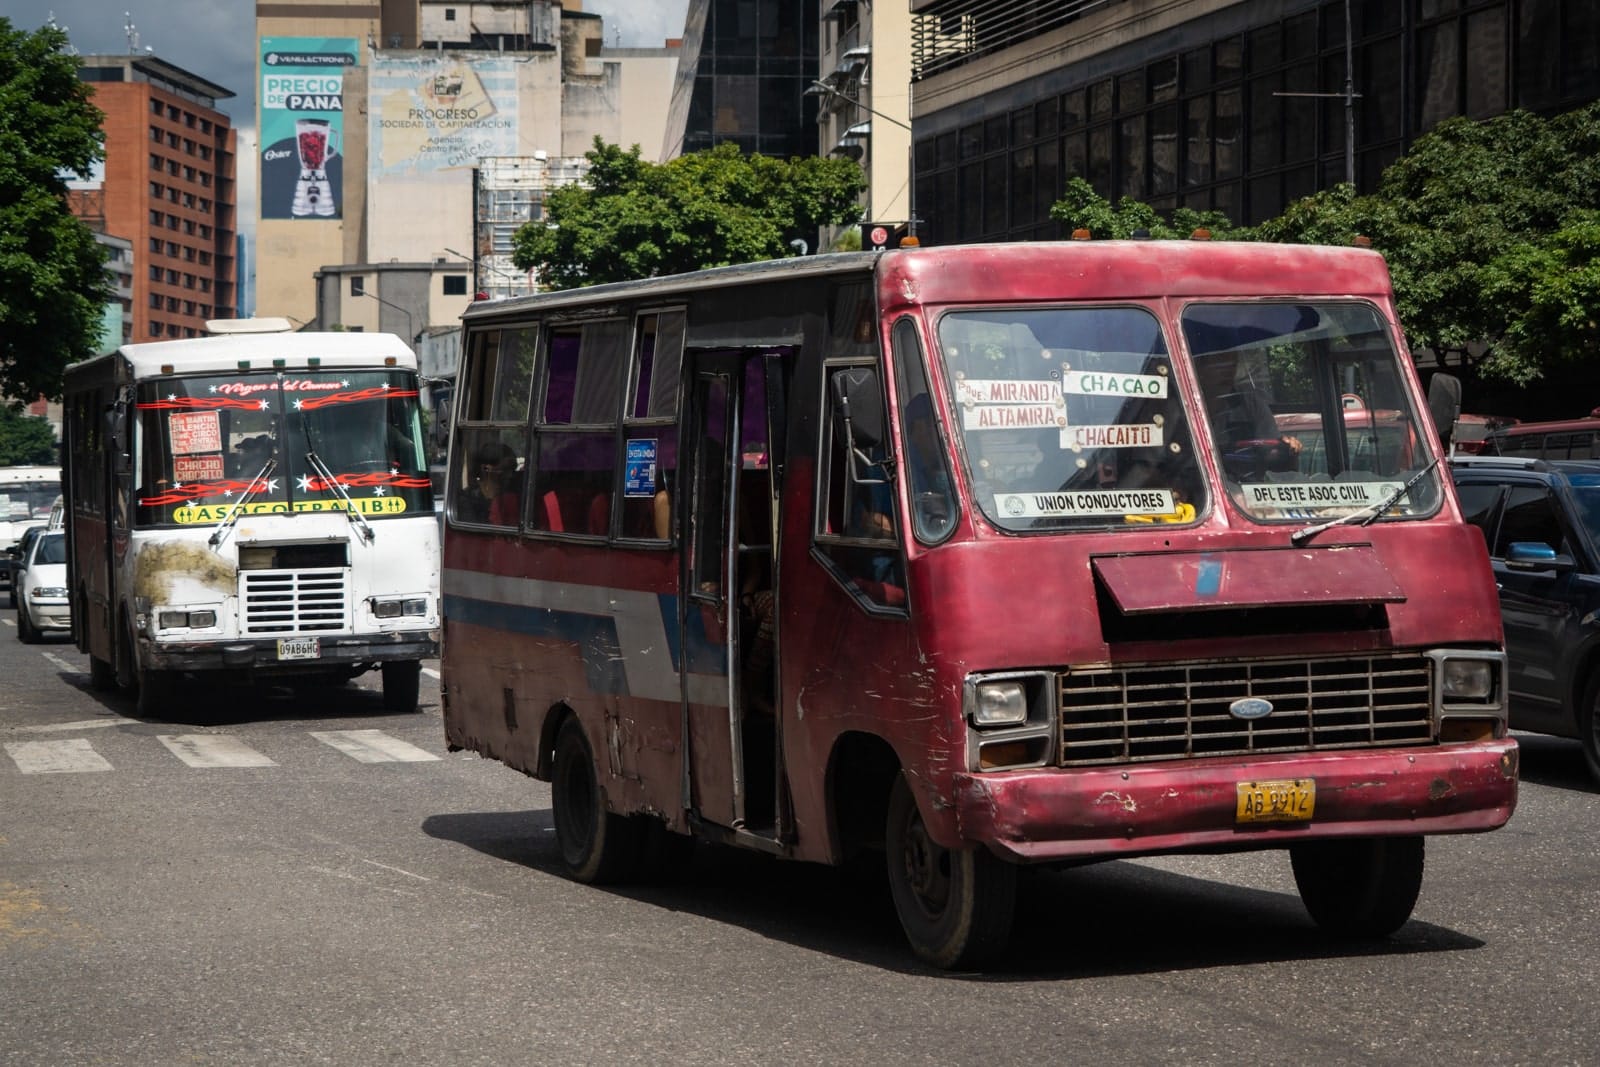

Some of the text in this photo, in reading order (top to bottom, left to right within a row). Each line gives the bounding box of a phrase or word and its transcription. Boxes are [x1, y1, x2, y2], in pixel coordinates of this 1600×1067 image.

[267, 79, 340, 93] PRECIO
[267, 94, 342, 110] DE PANA
[408, 108, 478, 120] PROGRESO
[990, 382, 1060, 401] MIRANDA
[1080, 374, 1161, 395] CHACAO
[979, 406, 1056, 427] ALTAMIRA
[1075, 426, 1151, 446] CHACAITO
[1035, 493, 1165, 511] UNION CONDUCTORES
[1278, 487, 1306, 502] ESTE
[1308, 486, 1338, 501] ASOC
[1339, 485, 1370, 501] CIVIL
